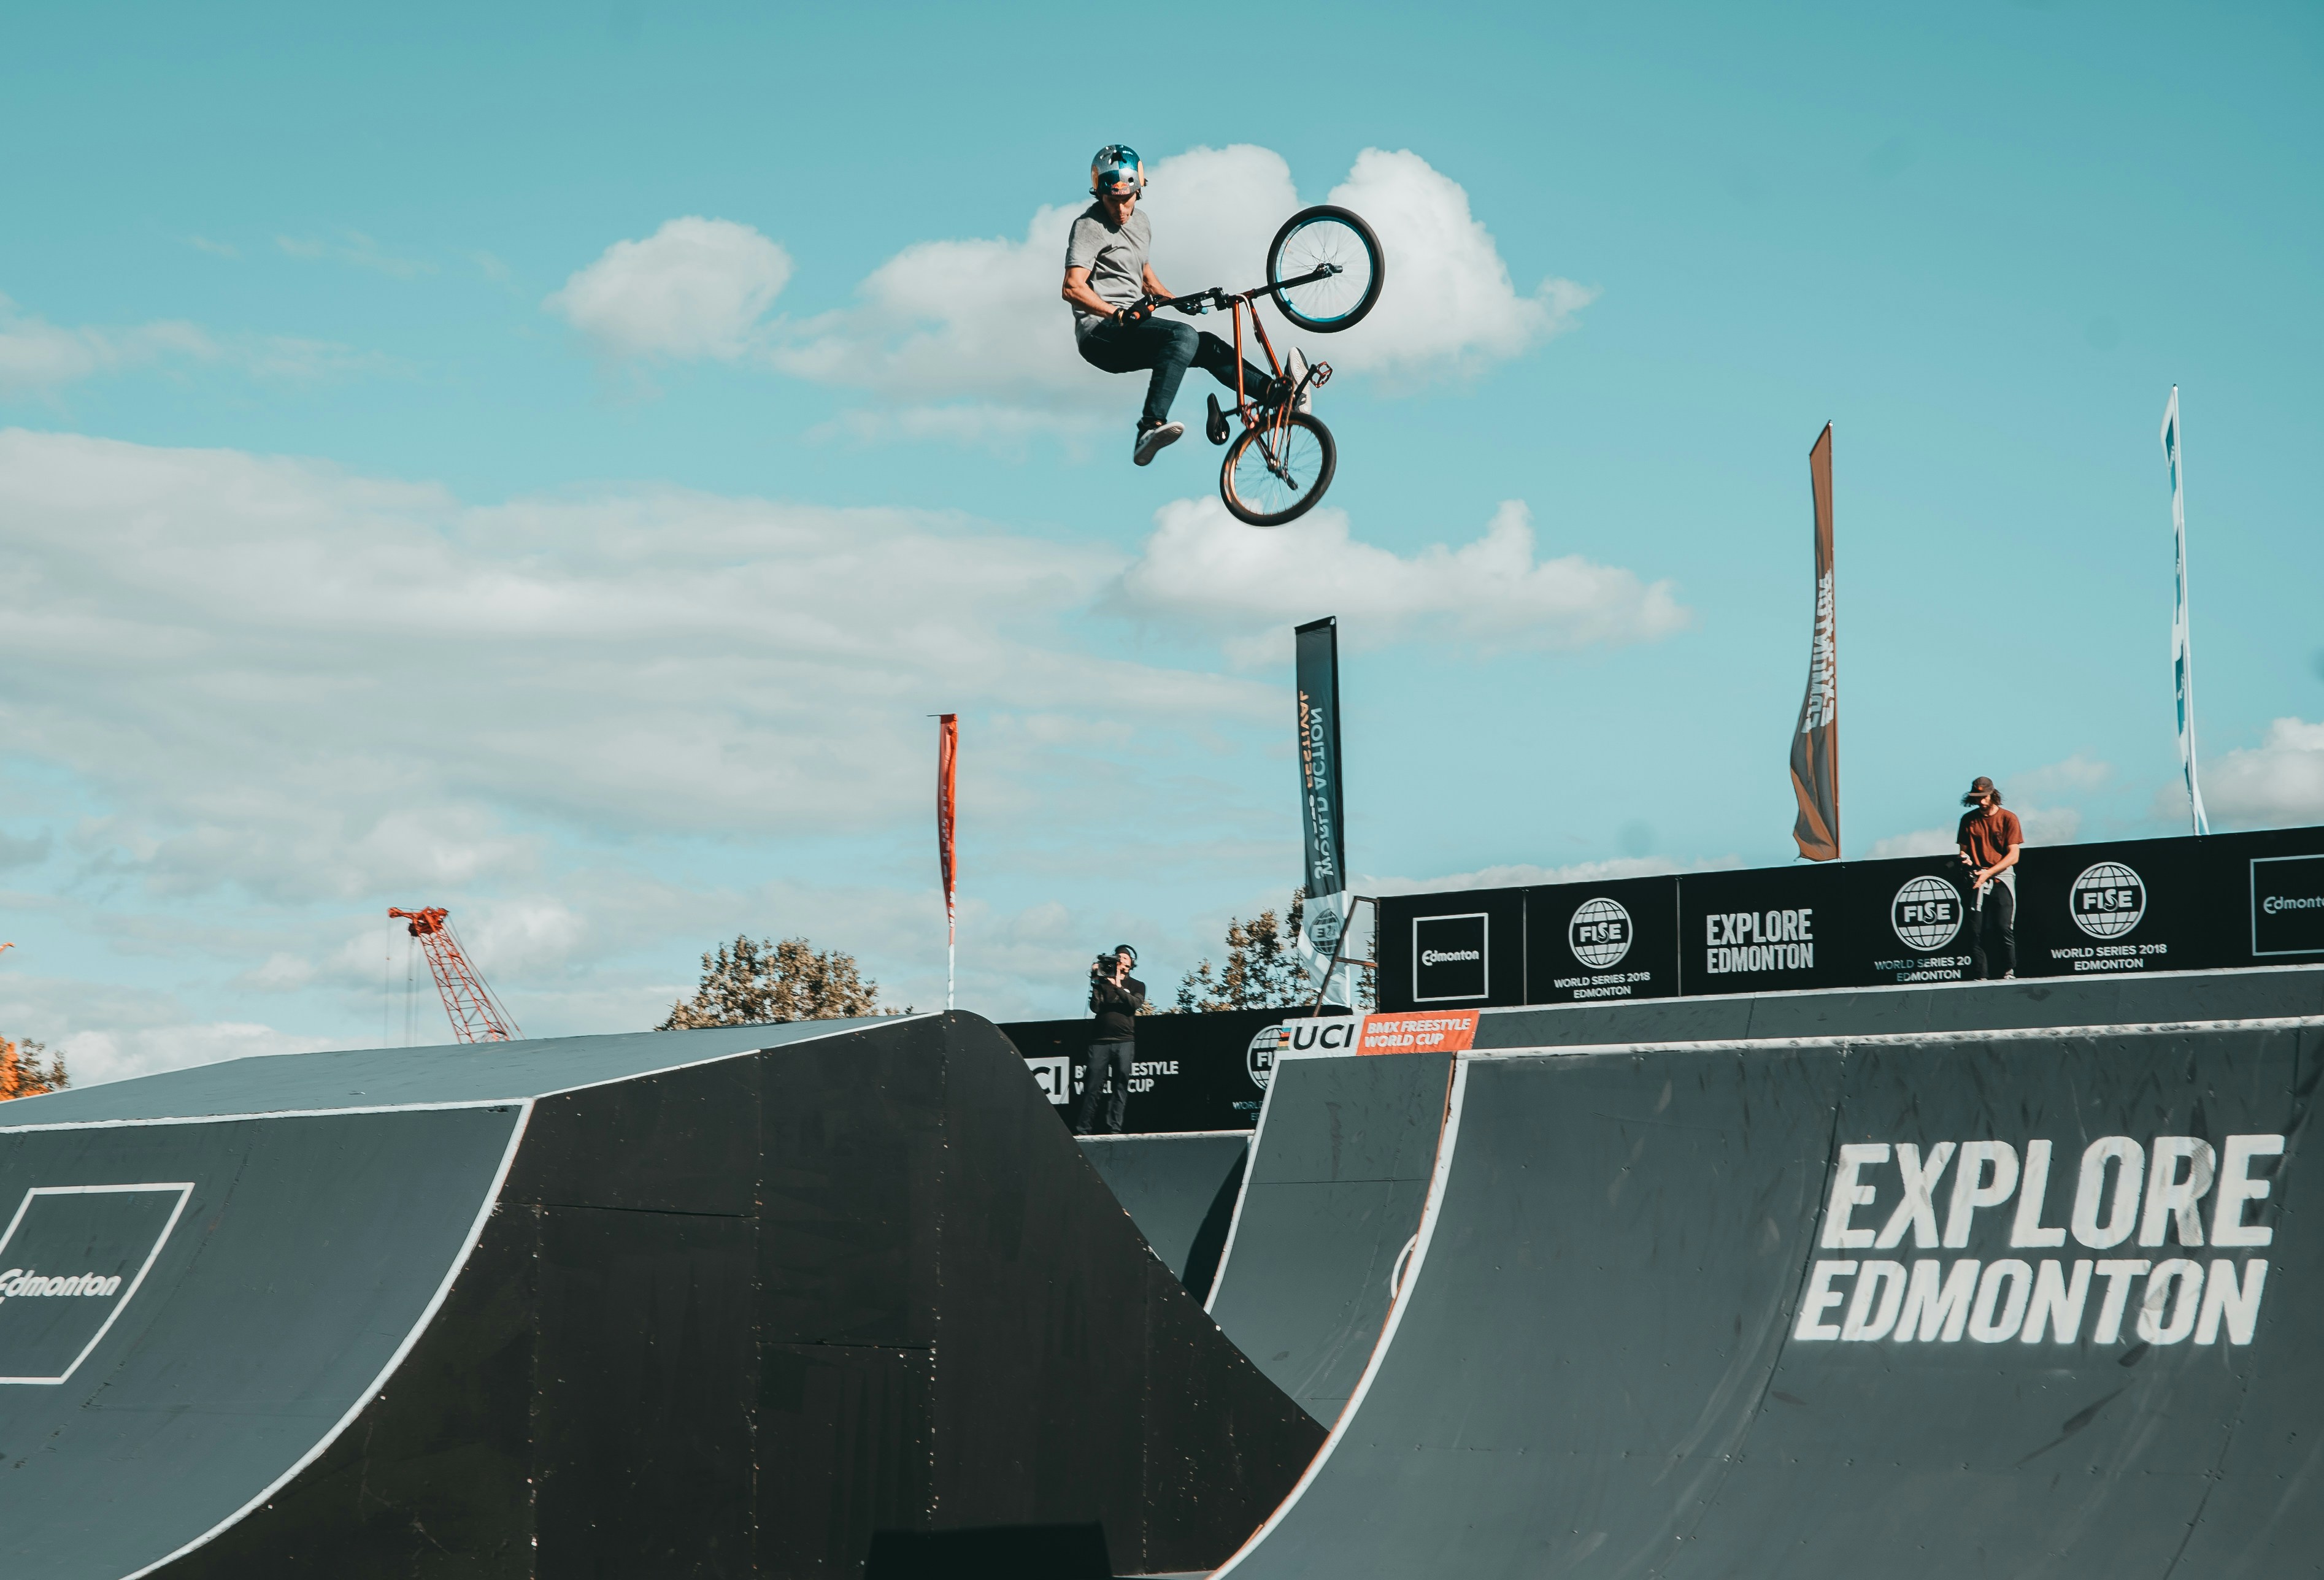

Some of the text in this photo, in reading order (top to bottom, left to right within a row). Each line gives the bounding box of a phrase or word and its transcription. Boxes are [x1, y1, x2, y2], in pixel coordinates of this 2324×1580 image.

[2084, 889, 2133, 911] FISE
[2263, 895, 2324, 914] Edmont
[1904, 902, 1951, 924] FISE
[1579, 922, 1622, 943] FISE
[1707, 908, 1813, 946] EXPLORE
[1422, 949, 1479, 966] Edmonton
[1707, 943, 1814, 973] EDMONTON
[2051, 943, 2168, 959] WORLD SERIES 2018
[1874, 956, 1972, 970] WORLD SERIES 20
[2074, 958, 2144, 971] EDMONTON
[1554, 972, 1650, 988] WORLD SERIES 2018
[1896, 970, 1961, 981] EDMONTON
[1573, 986, 1631, 999] EDMONTON
[1367, 1018, 1472, 1034] BMX FREESTYLE
[1293, 1024, 1355, 1051] UCI
[1364, 1033, 1444, 1048] WORLD CUP
[1256, 1051, 1272, 1067] FI
[1108, 1061, 1179, 1077] ESTYLE
[1030, 1066, 1061, 1095] CI
[1127, 1078, 1155, 1092] CUP
[1820, 1134, 2285, 1249] EXPLORE
[1794, 1258, 2269, 1345] EDMONTON
